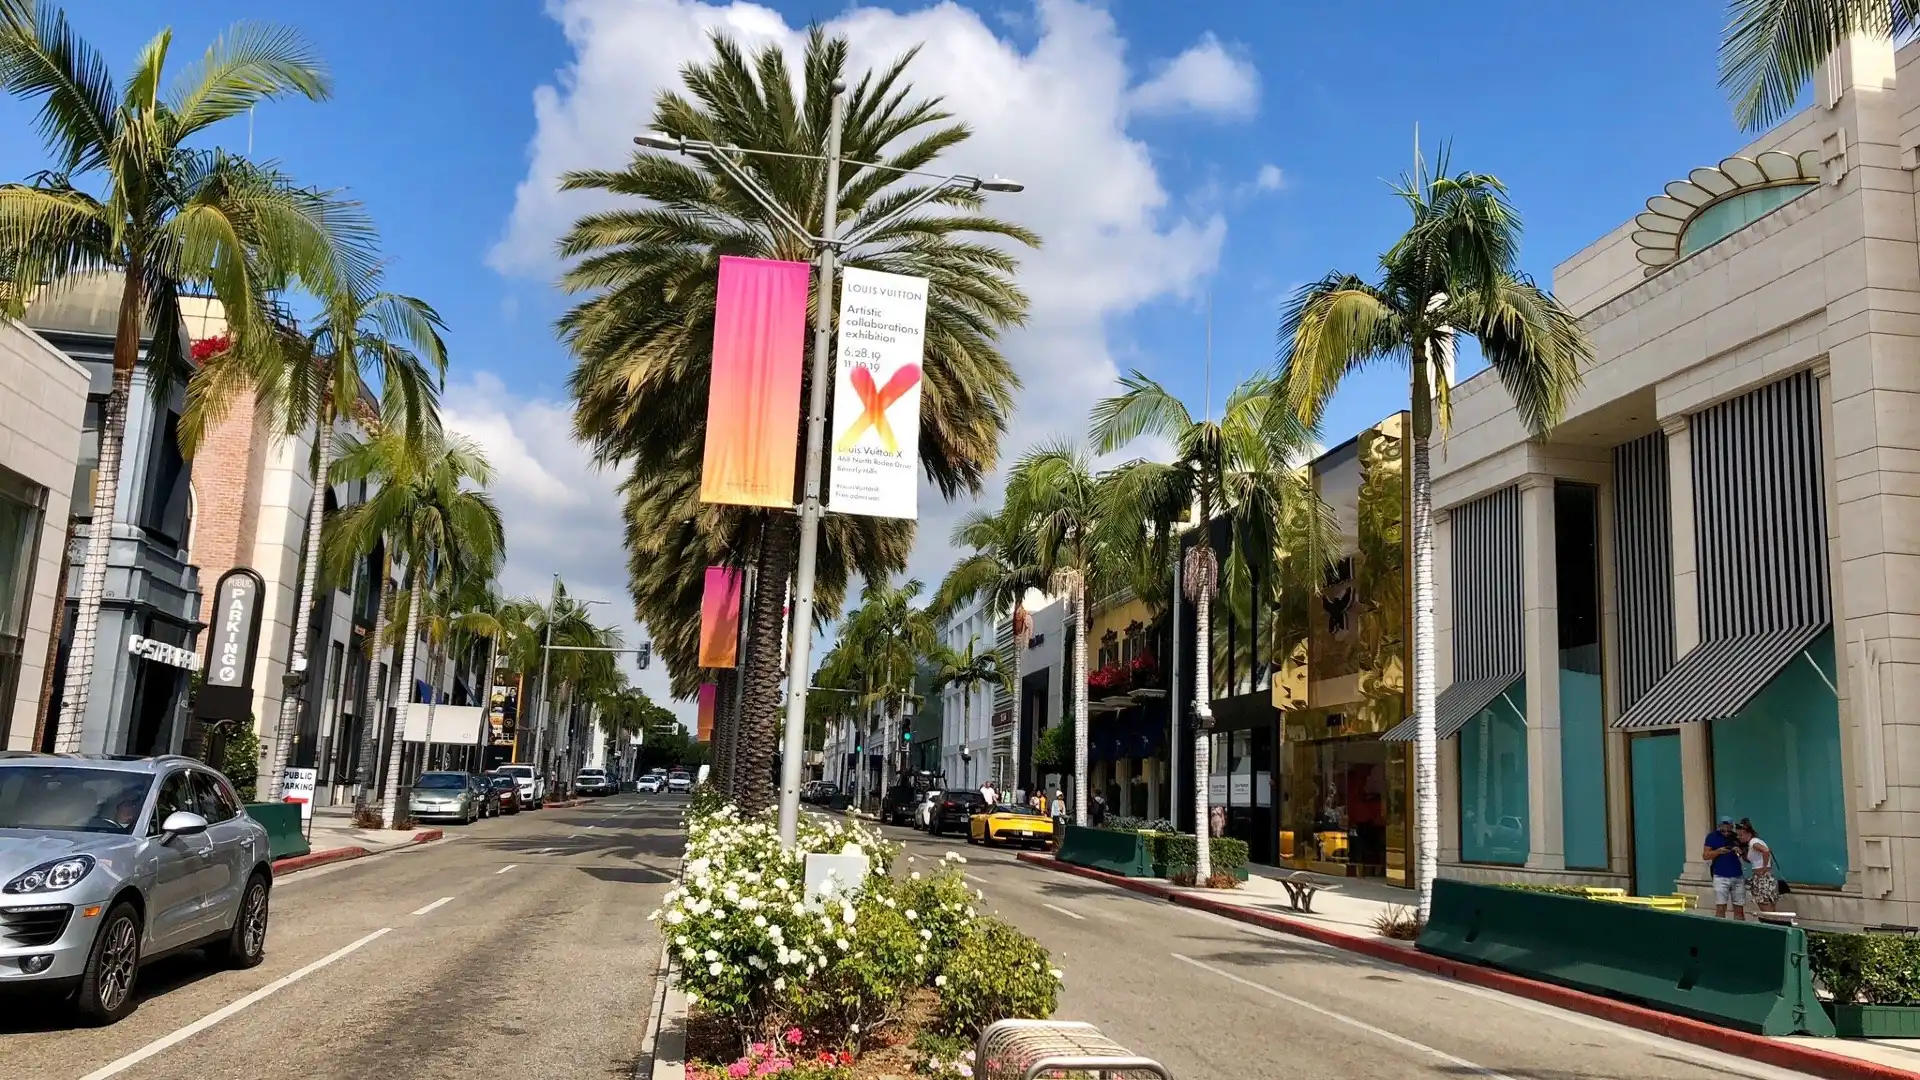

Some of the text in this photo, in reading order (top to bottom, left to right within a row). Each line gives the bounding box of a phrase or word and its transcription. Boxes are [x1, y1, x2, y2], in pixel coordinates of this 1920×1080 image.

[848, 283, 922, 301] LOUIS VUITTON
[847, 304, 882, 318] Artistic
[846, 318, 919, 335] collaborations
[845, 329, 896, 343] exhibition
[844, 346, 881, 362] 6.28.19
[838, 445, 903, 459] Luis Vuitton X
[852, 457, 872, 465] North
[227, 579, 253, 588] PUBLIC
[221, 588, 246, 666] PARKING
[283, 771, 313, 780] PUBLIC
[280, 782, 313, 791] PARKING
